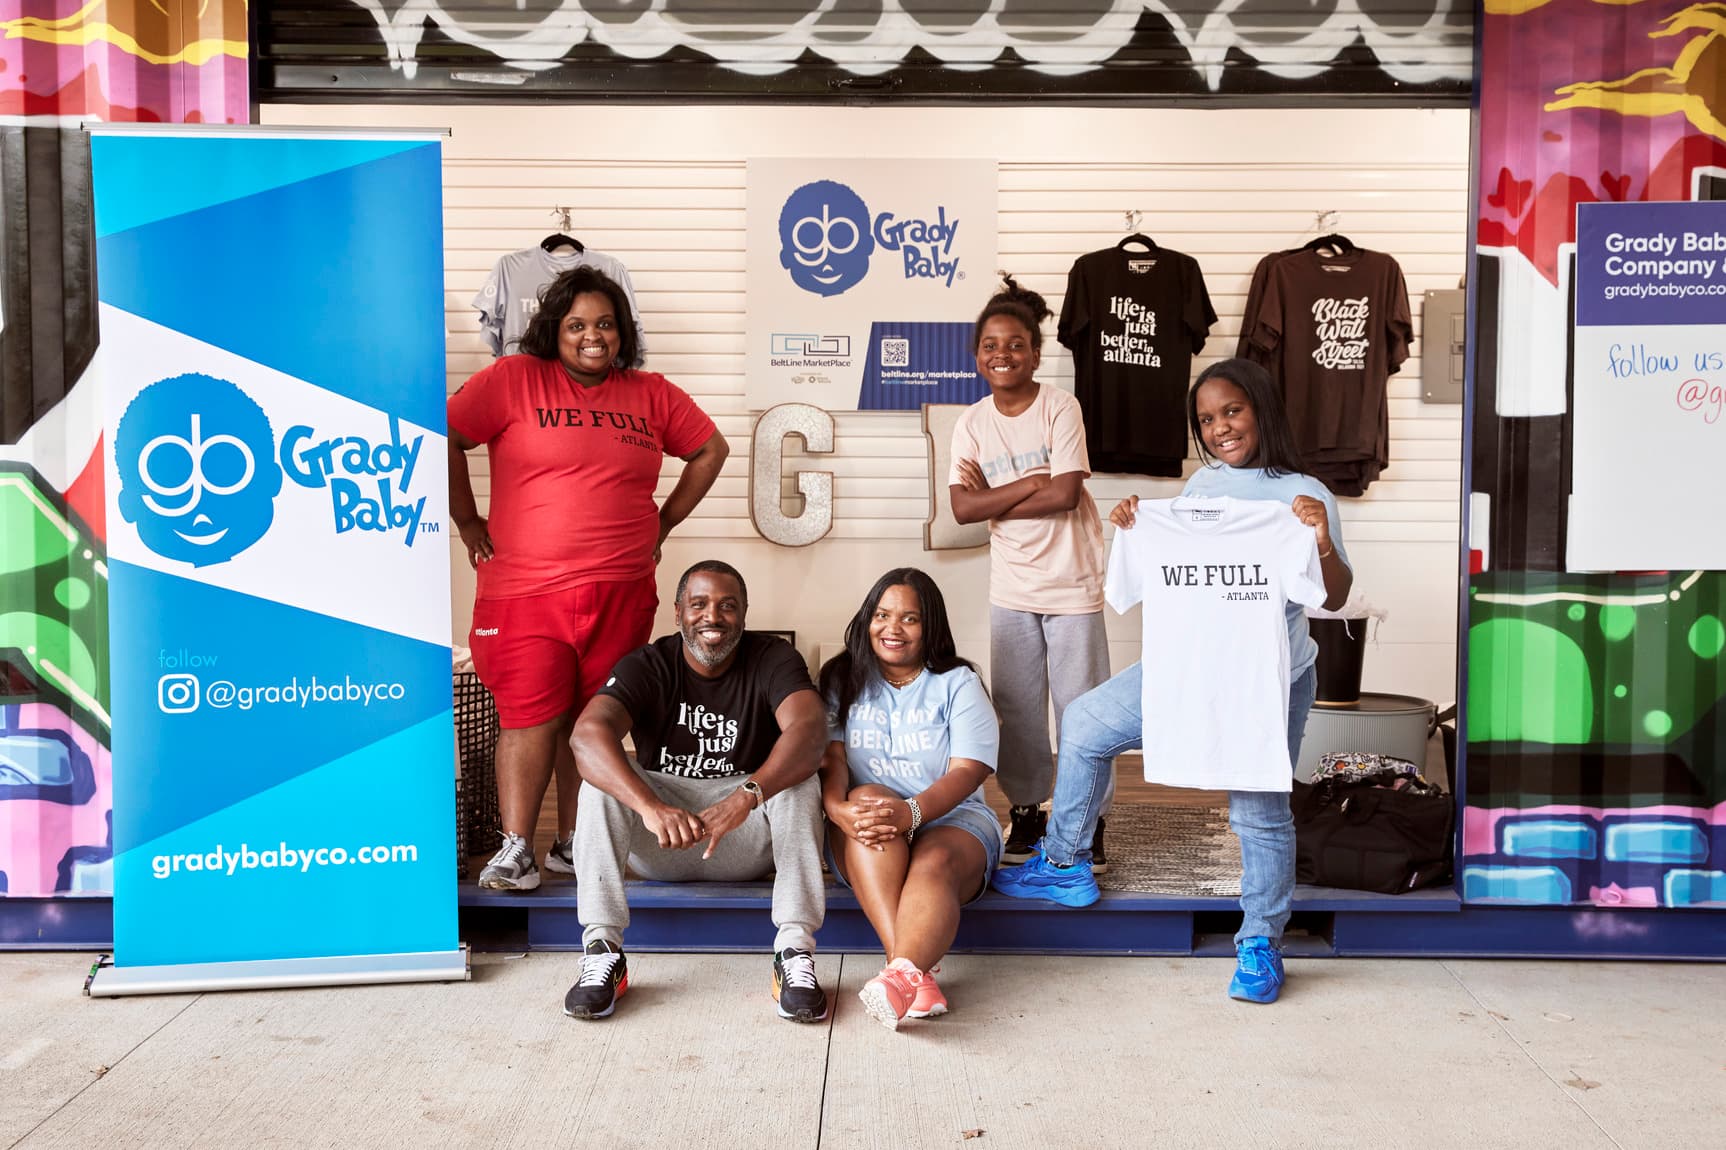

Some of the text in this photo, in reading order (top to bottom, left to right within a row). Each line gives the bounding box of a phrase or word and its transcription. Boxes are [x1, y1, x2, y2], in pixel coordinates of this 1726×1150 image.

[874, 206, 959, 255] Grady
[1605, 232, 1726, 256] Grady Bab
[903, 245, 959, 288] Baby
[1605, 256, 1716, 280] Company
[1604, 283, 1726, 300] gradybabyco.co
[1109, 296, 1156, 324] life is
[1312, 296, 1369, 322] Black
[1124, 318, 1156, 337] just
[1316, 319, 1366, 341] Wall
[1101, 330, 1154, 353] better in
[1312, 339, 1370, 369] Street
[770, 359, 851, 367] BeltLine MarketPlace
[1103, 350, 1161, 368] atlanta
[1607, 343, 1724, 378] follow us
[881, 369, 977, 379] beltline.org/marketplace
[1677, 378, 1726, 424] @g
[536, 408, 654, 438] WE FULL
[280, 415, 424, 494] Grady
[749, 402, 836, 547] G
[331, 477, 427, 548] Baby
[1162, 564, 1268, 586] WE FULL
[158, 649, 218, 668] follow
[206, 675, 405, 710] @gradybabyco
[677, 702, 738, 737] life is
[660, 746, 726, 771] better
[721, 760, 734, 773] in
[152, 842, 418, 879] gradybabyco.com
